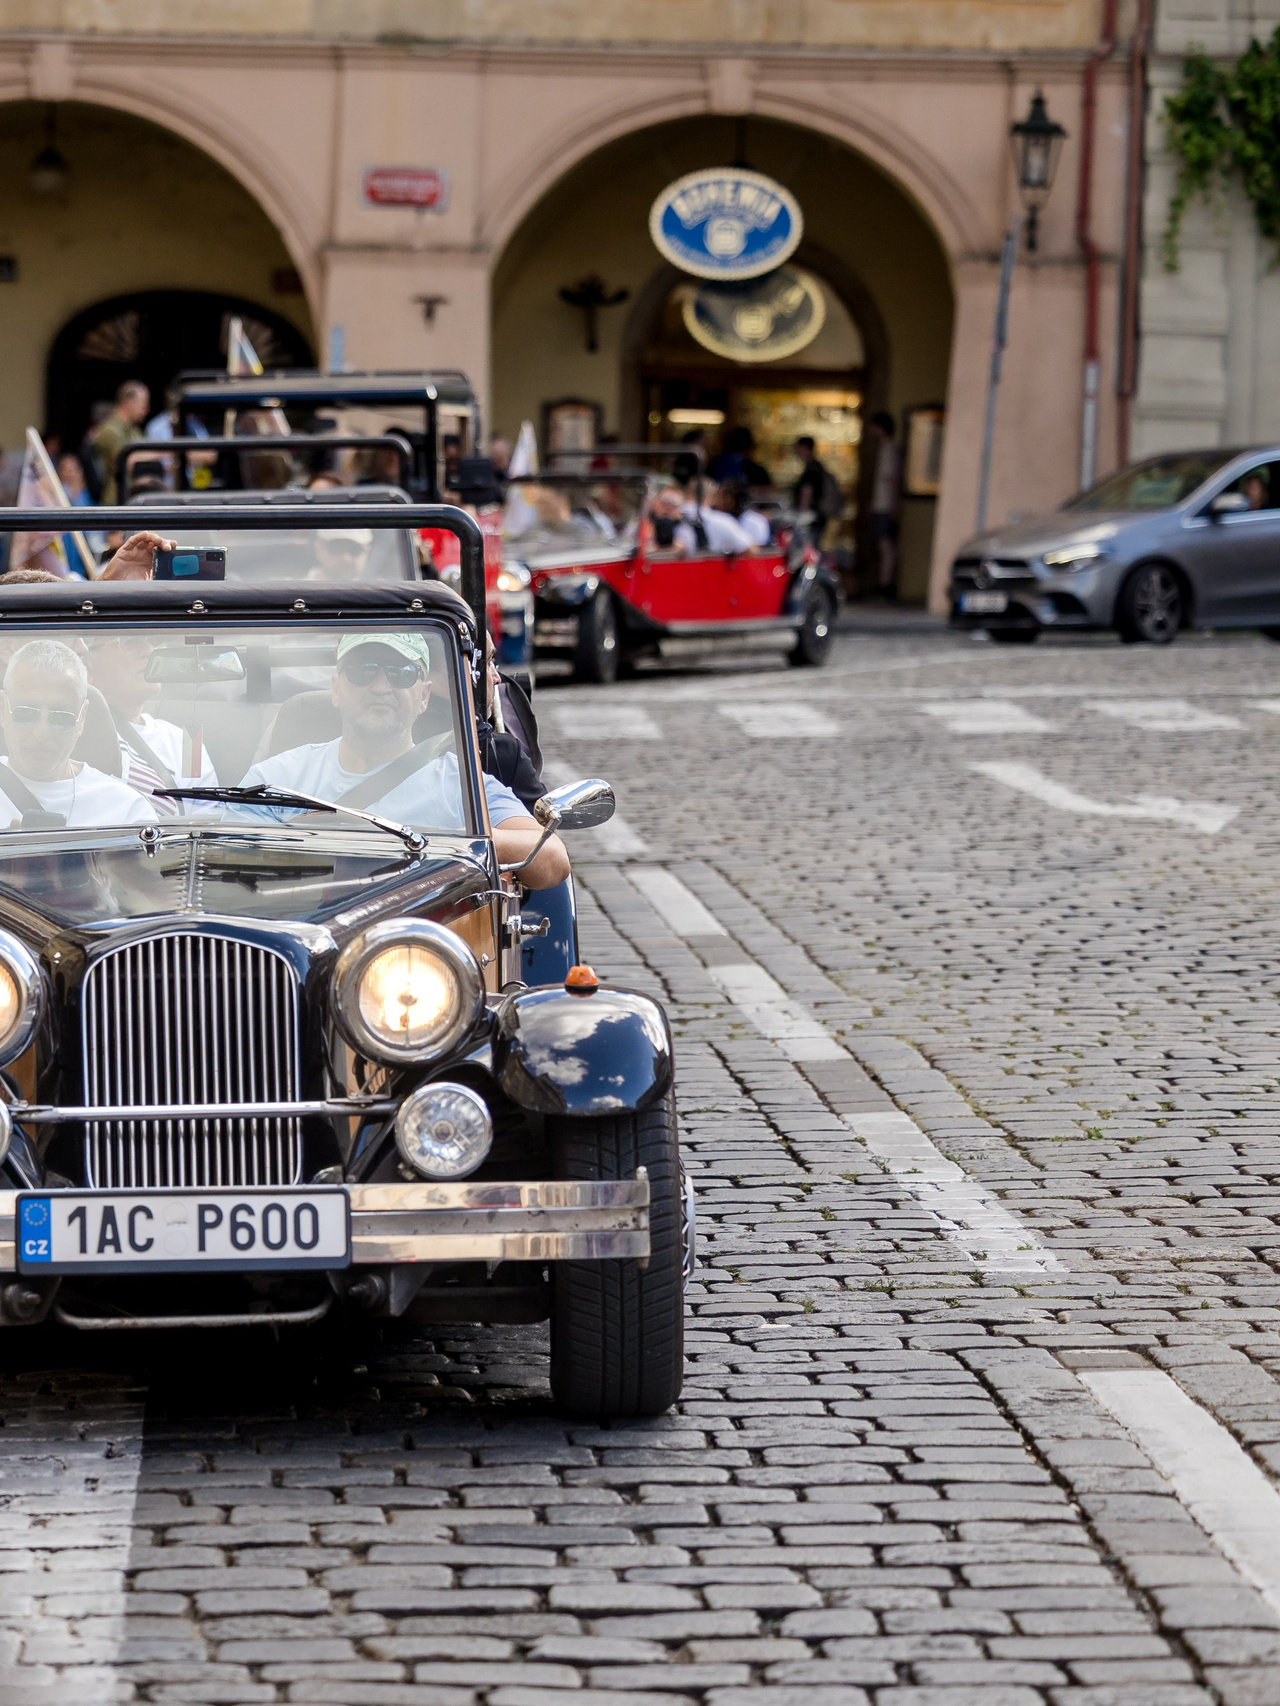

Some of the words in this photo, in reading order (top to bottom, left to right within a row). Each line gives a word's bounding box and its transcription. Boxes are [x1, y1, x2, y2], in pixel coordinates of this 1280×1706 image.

[67, 1204, 155, 1254] 1AC
[197, 1202, 320, 1252] P600
[24, 1239, 48, 1255] CZ
